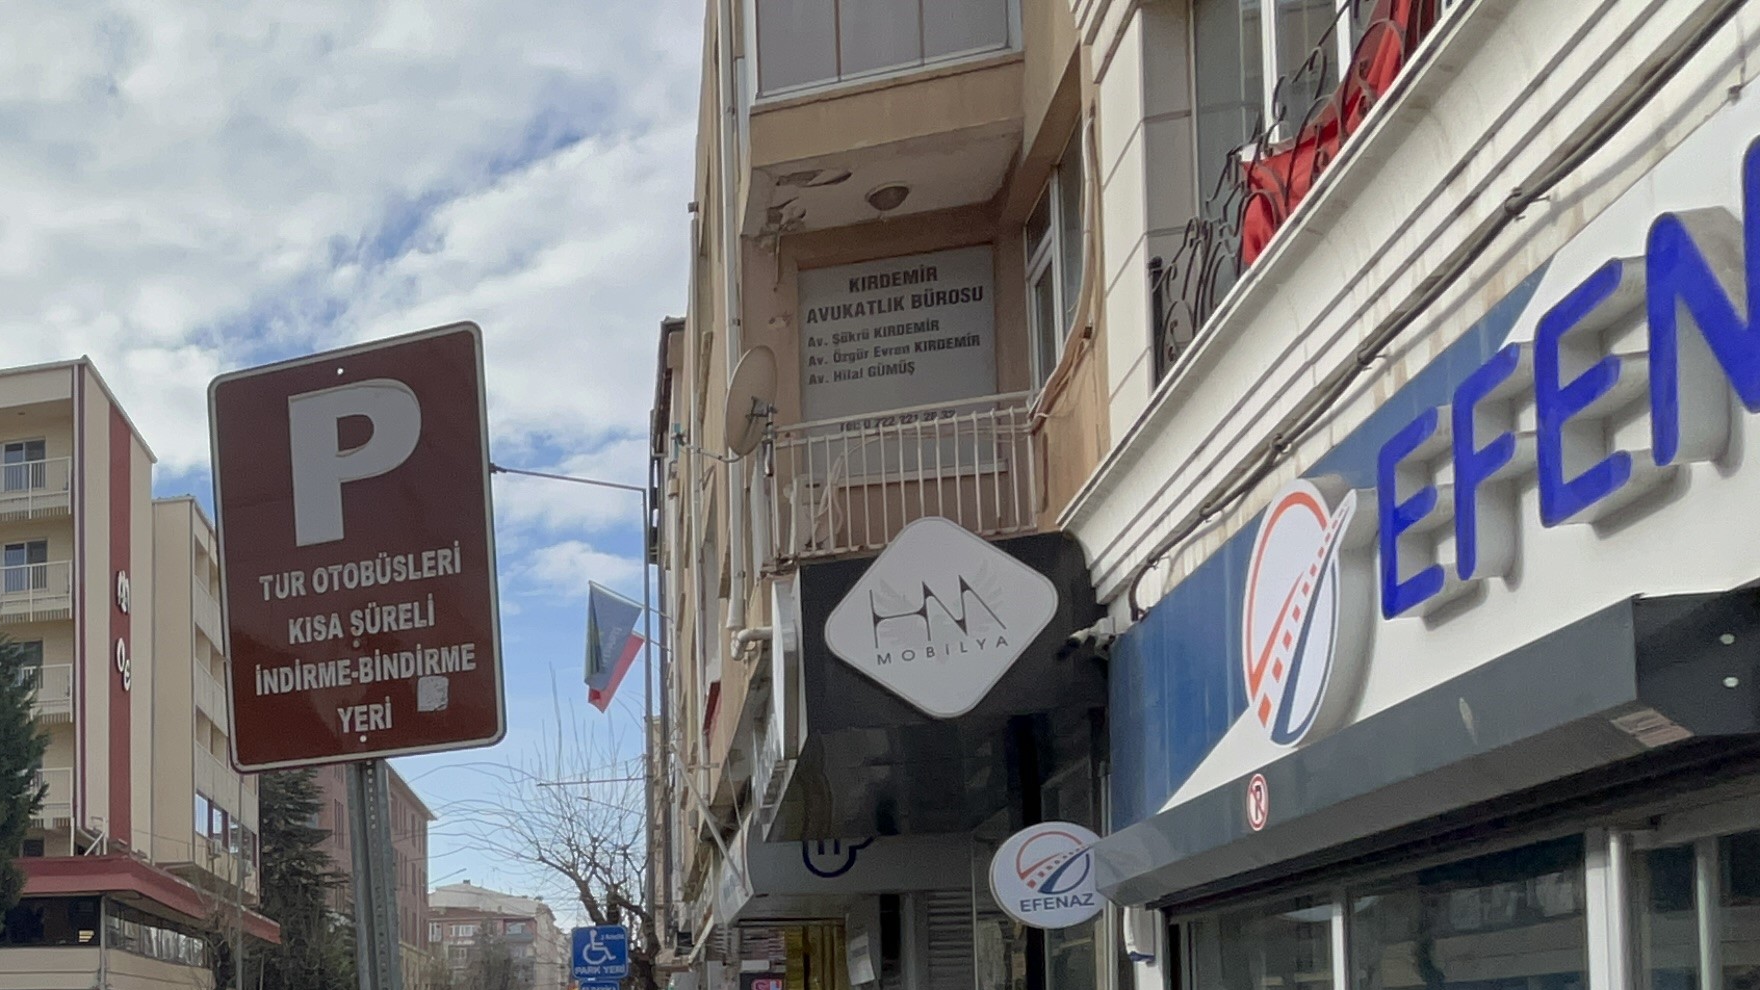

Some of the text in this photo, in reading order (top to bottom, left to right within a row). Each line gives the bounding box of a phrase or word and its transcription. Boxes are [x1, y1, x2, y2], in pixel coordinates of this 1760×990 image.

[849, 265, 938, 293] KIRDEMİR
[806, 285, 984, 324] AVUKATLIK BÜROSU
[807, 335, 828, 348] Av.
[873, 319, 940, 339] KIRDEMİR
[808, 355, 828, 367] Av.
[914, 333, 981, 353] KIRDEMİR
[808, 360, 916, 386] Av. Hilal GÜMÜŞ
[287, 378, 423, 548] P
[259, 541, 461, 601] TUR OTOBÜSLERİ
[288, 613, 343, 644] KISA
[256, 642, 477, 696] İNDİRME-BİNDİRME
[337, 695, 393, 734] YERİ
[1020, 893, 1095, 912] EFENAZ
[574, 965, 601, 975] PARK
